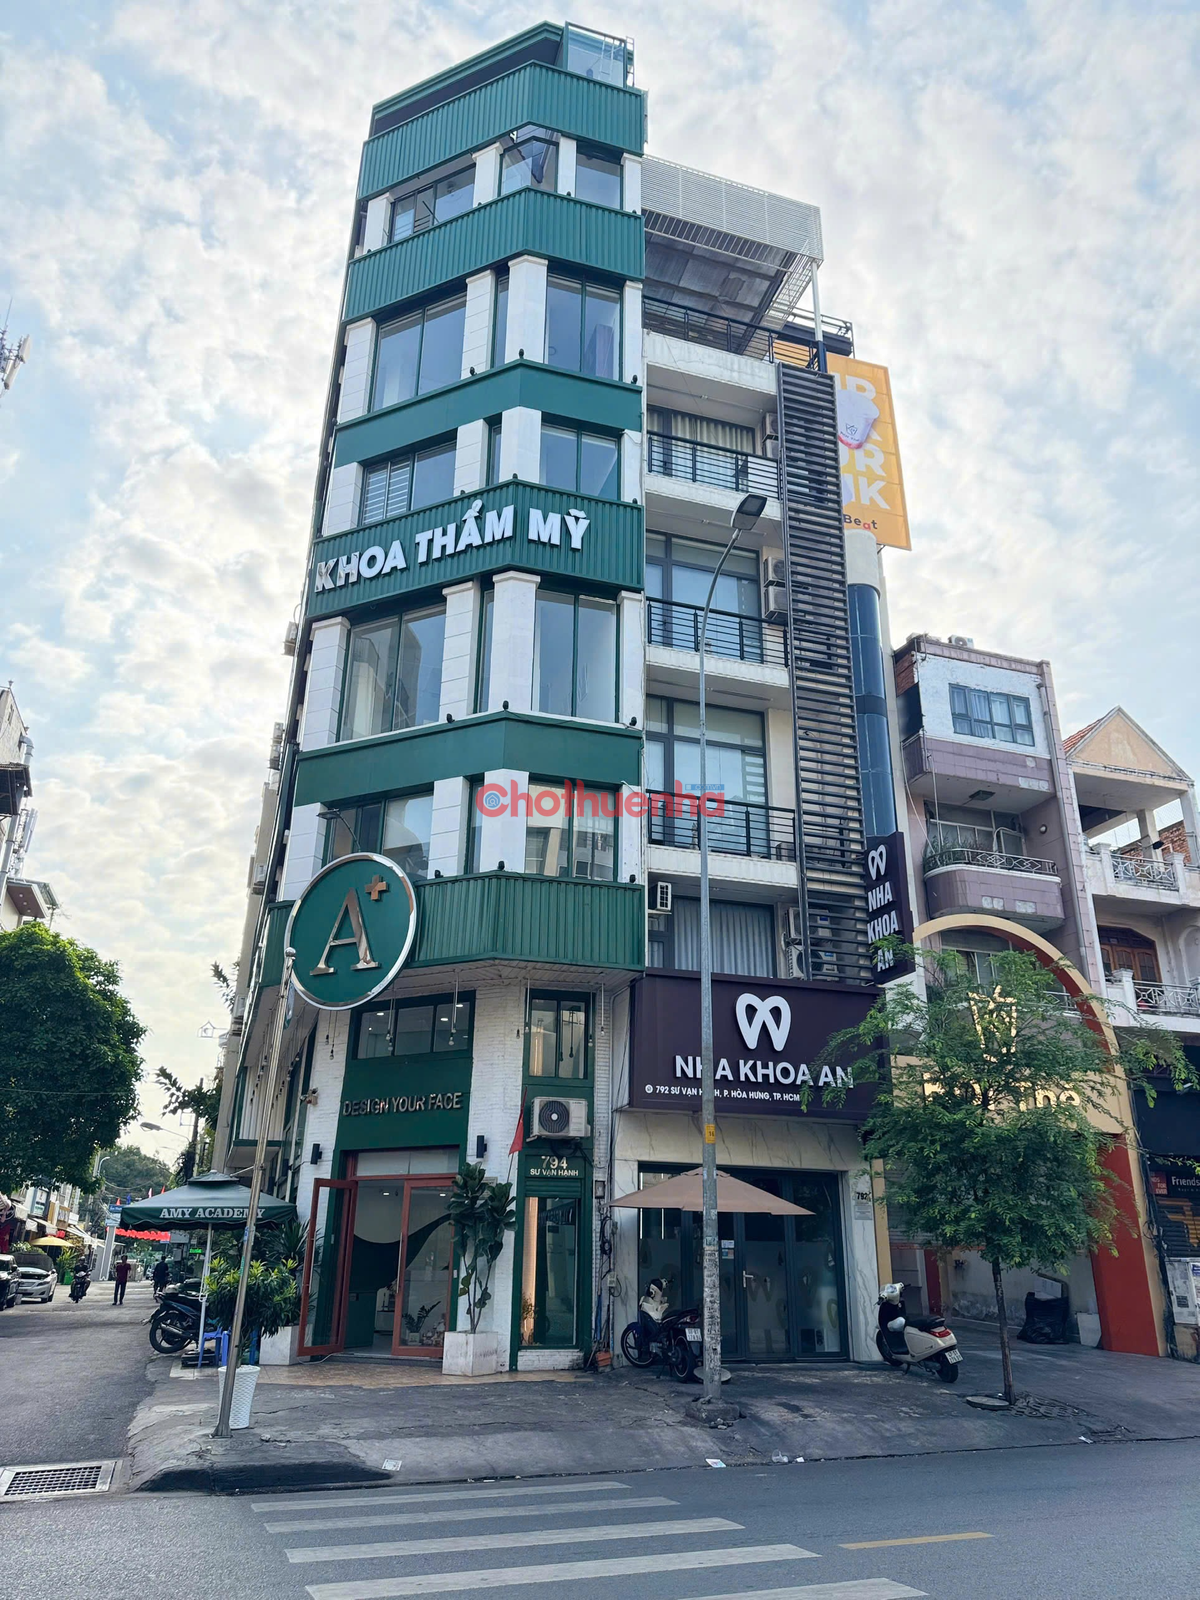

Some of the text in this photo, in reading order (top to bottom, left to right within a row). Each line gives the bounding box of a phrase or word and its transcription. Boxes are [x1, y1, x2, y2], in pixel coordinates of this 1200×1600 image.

[314, 499, 590, 593] KHOA THẨM MỸ
[867, 881, 893, 912] NHA
[867, 910, 899, 944] KHOA
[739, 1059, 814, 1087] KHOA
[343, 1092, 462, 1116] DESIGN YOUR FACE
[656, 1086, 669, 1094] 792
[670, 1086, 681, 1095] SƯ
[682, 1088, 698, 1097] VẠN
[723, 1090, 730, 1098] P.
[731, 1088, 747, 1098] HÒA
[530, 1168, 579, 1177] SƯ VẠN HẠNH
[541, 1155, 568, 1169] 794
[159, 1207, 194, 1219] AMY
